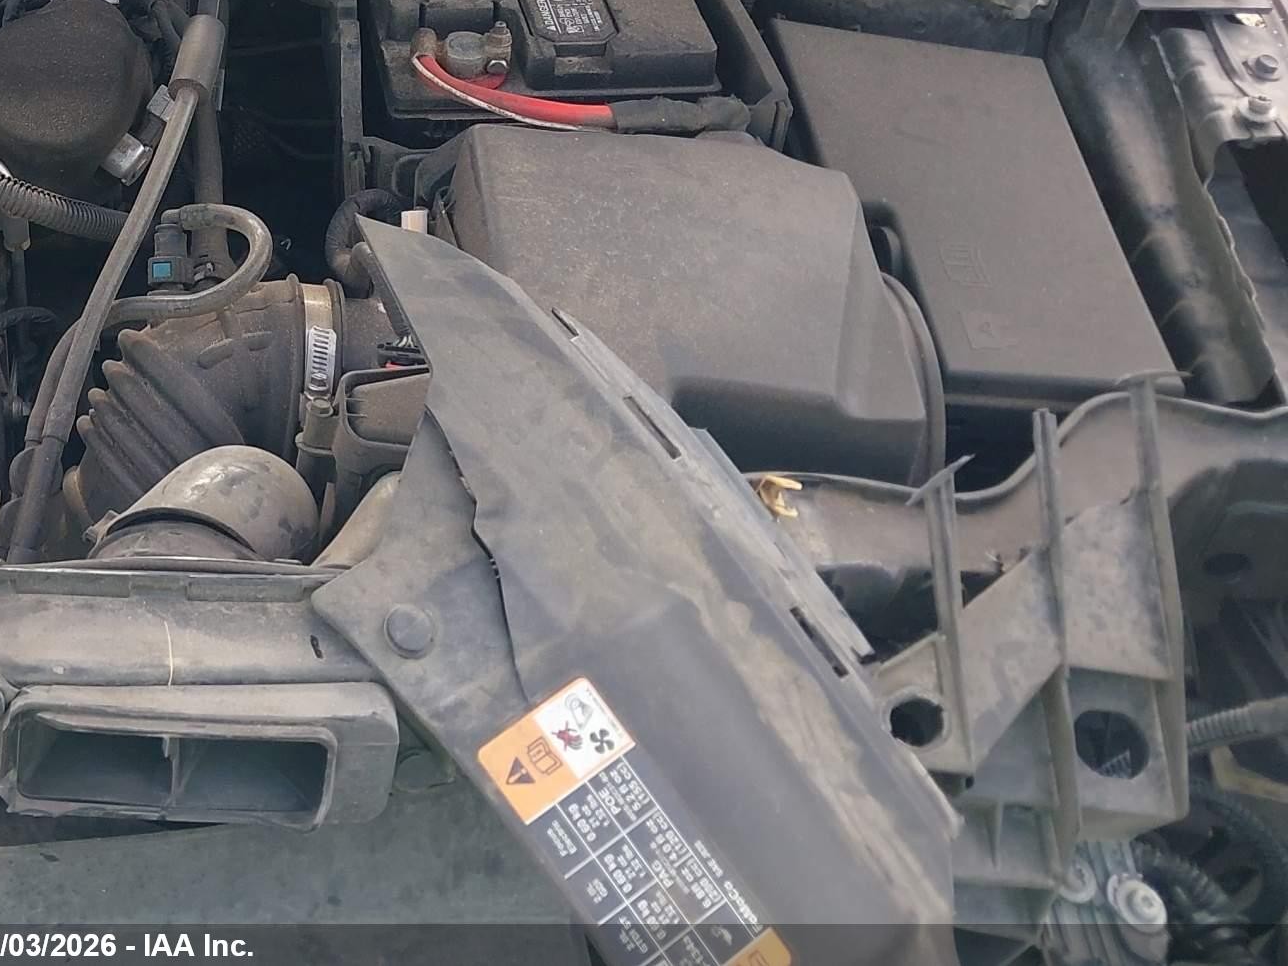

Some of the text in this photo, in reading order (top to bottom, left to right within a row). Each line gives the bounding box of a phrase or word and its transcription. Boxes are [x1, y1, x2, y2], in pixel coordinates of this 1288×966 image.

[609, 769, 622, 784] oz
[616, 762, 632, 780] cc)
[599, 787, 620, 814] POE
[629, 779, 649, 804] (155
[625, 792, 641, 810] 5.2
[566, 802, 582, 820] kg
[646, 819, 658, 833] oz
[652, 812, 668, 830] cc)
[661, 842, 678, 861] 4.0
[601, 852, 618, 870] kg
[650, 859, 673, 887] PAG
[635, 899, 652, 917] kg
[722, 879, 763, 932] FoMoCo
